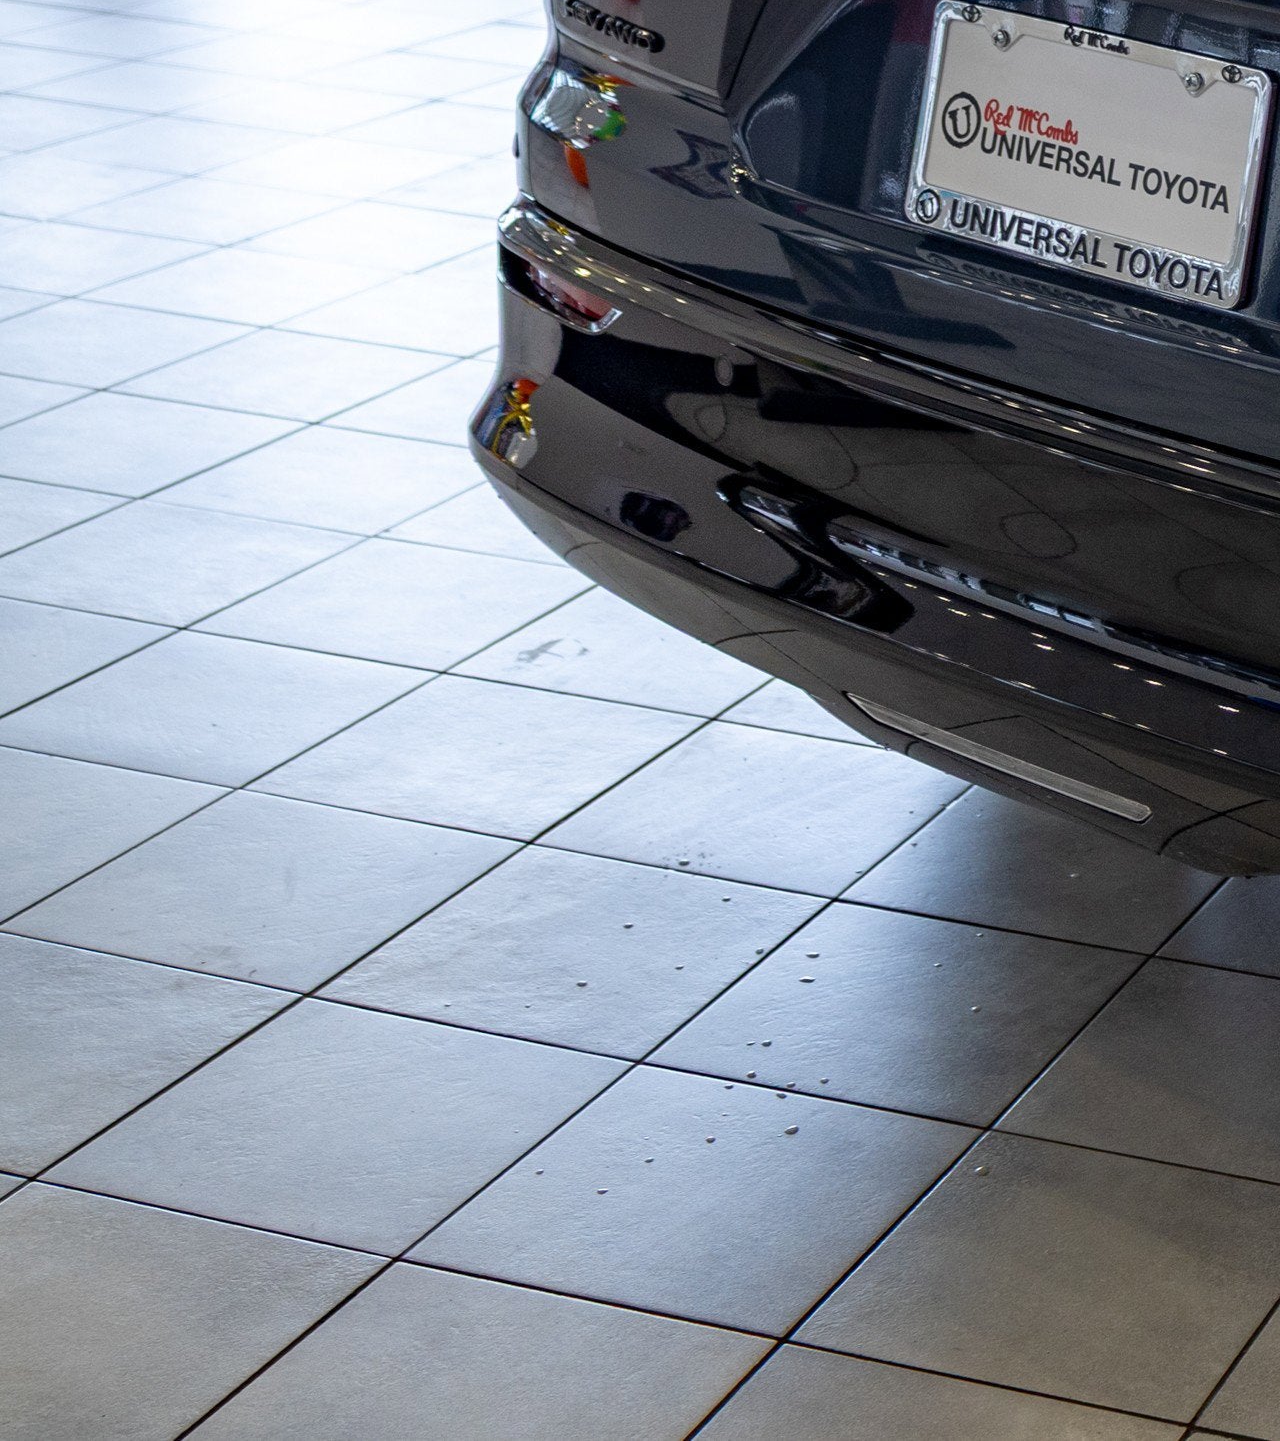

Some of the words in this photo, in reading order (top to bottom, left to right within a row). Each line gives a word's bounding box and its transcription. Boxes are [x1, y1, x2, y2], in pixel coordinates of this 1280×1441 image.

[984, 98, 1014, 136] Red
[1016, 106, 1079, 146] McCombs
[980, 126, 1122, 187] UNIVERSAL
[1127, 162, 1230, 214] TOYOTA
[950, 198, 1107, 269] UNIVERSAL
[1113, 242, 1225, 301] TOYOTA
